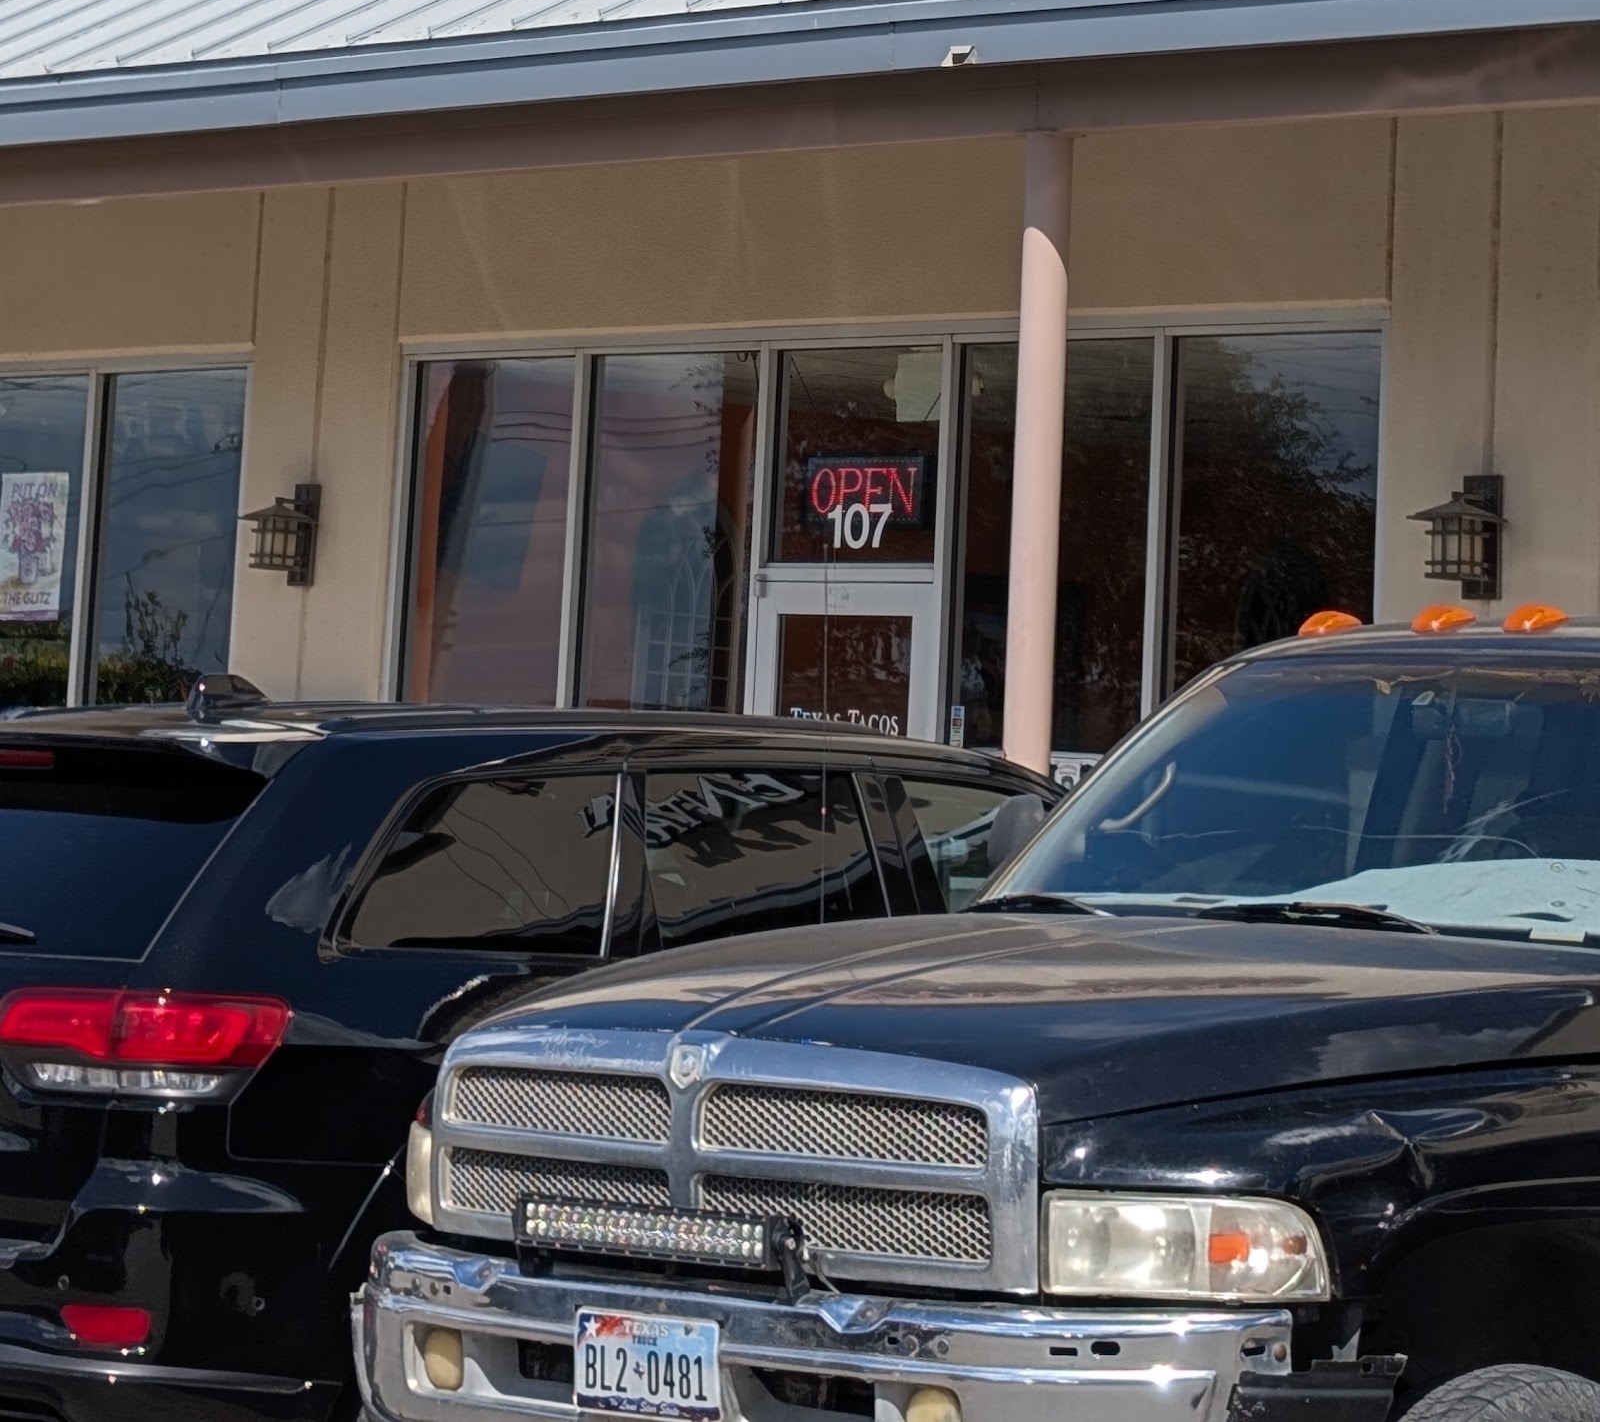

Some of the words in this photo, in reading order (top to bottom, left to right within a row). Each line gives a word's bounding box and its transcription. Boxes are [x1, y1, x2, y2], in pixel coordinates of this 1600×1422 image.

[811, 466, 918, 514] OPEN
[827, 502, 893, 550] 107
[622, 1320, 669, 1337] TEXAS
[585, 1343, 628, 1393] BL2
[647, 1349, 708, 1402] 0481
